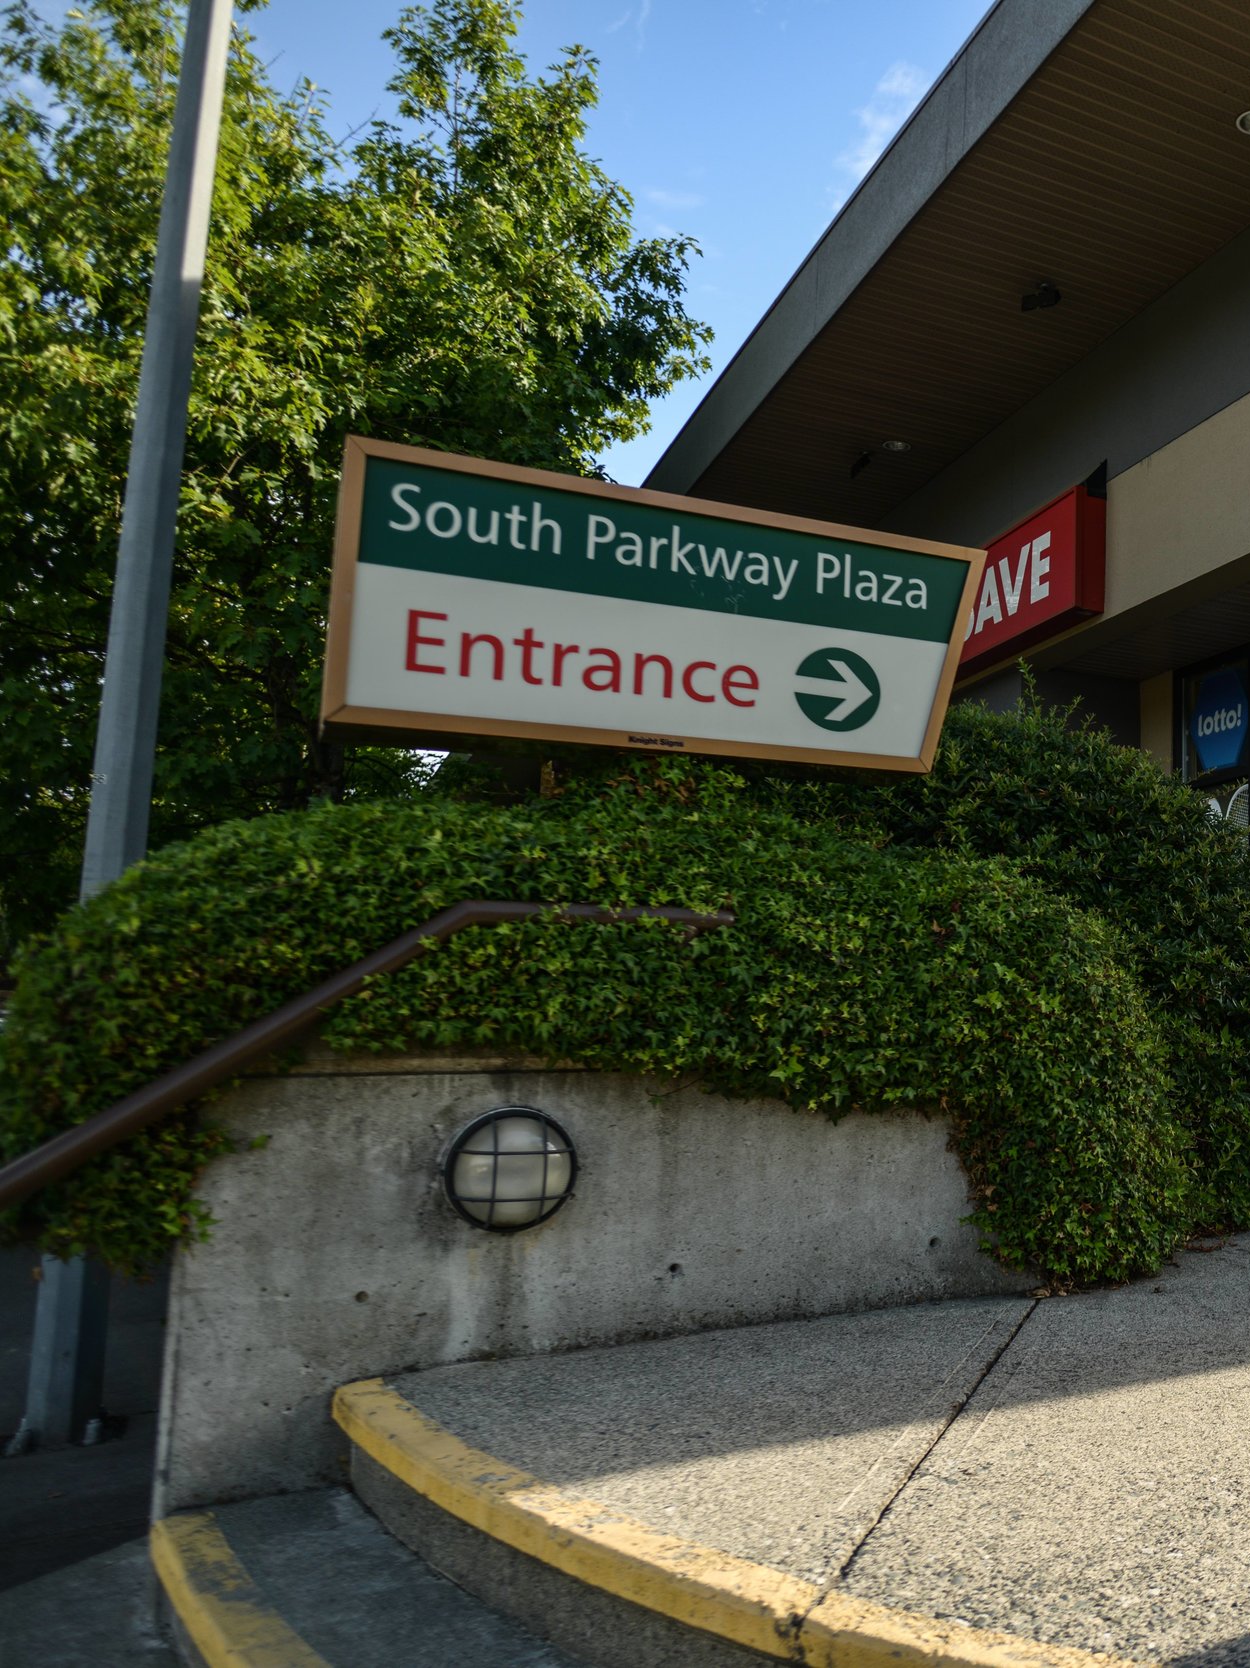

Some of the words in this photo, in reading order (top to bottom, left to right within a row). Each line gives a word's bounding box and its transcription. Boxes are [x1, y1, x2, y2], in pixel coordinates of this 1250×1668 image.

[388, 482, 562, 555] South
[586, 514, 799, 601] Parkway
[816, 552, 928, 610] Plaza
[964, 531, 1051, 641] AVE
[405, 609, 759, 707] Entrance
[628, 735, 658, 746] Knight
[659, 738, 684, 748] Signs
[1197, 703, 1242, 737] lotto!
